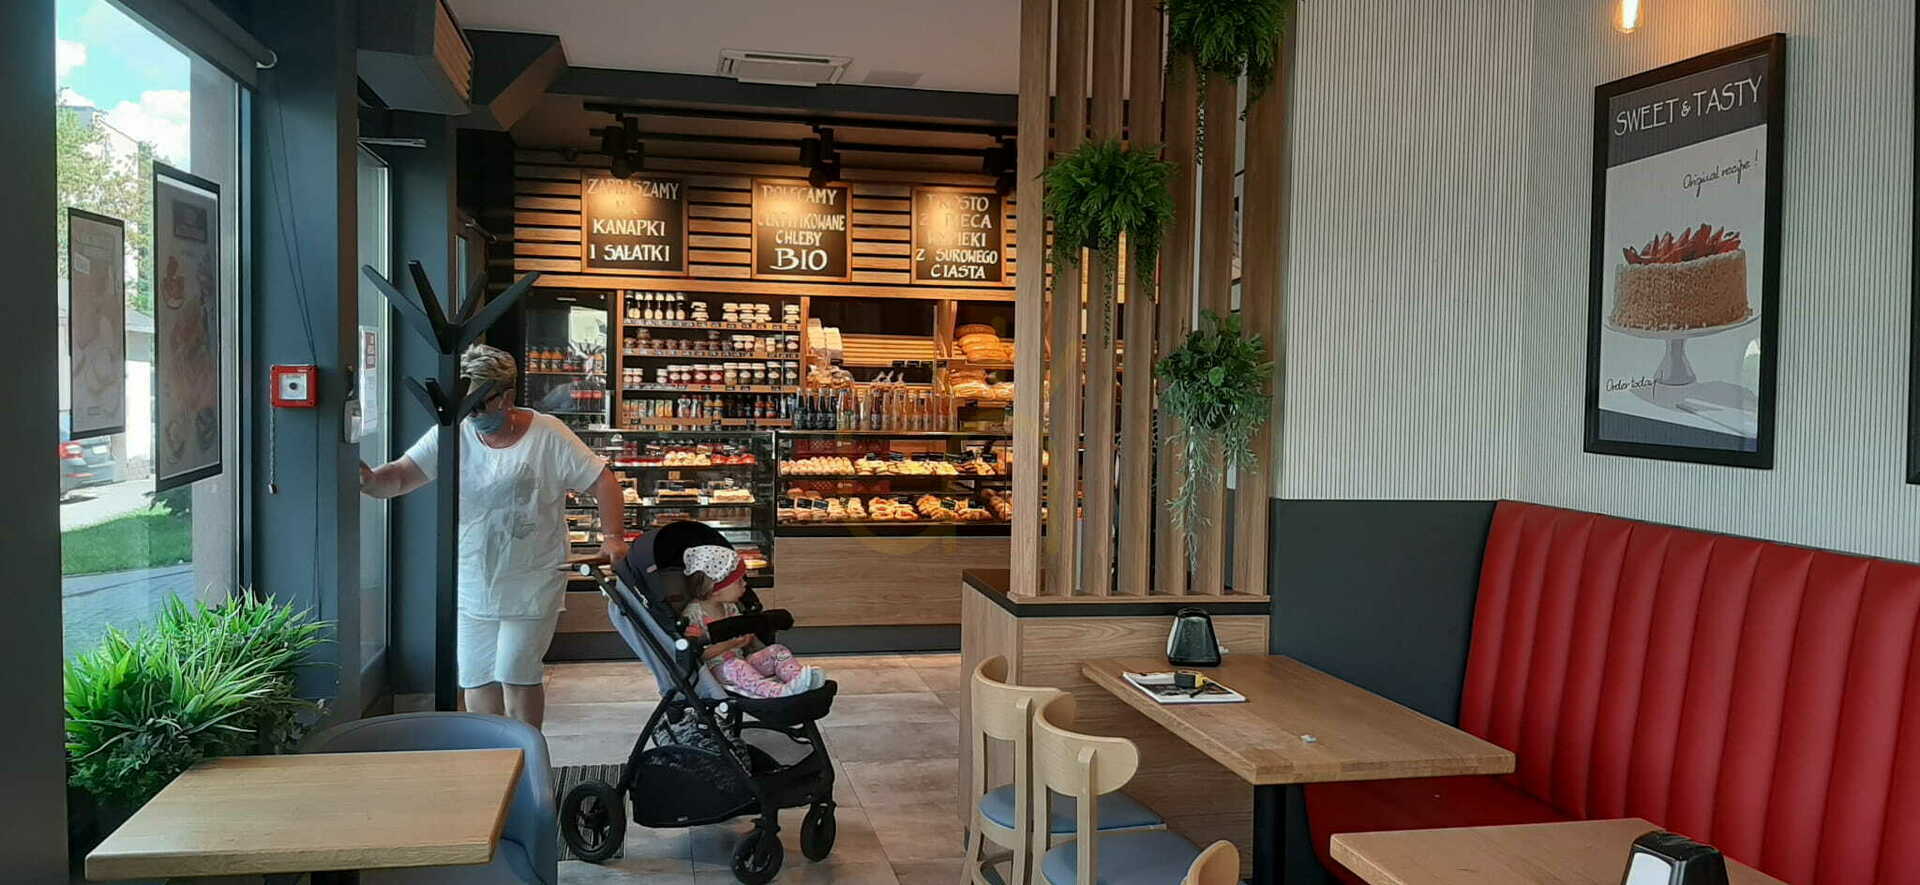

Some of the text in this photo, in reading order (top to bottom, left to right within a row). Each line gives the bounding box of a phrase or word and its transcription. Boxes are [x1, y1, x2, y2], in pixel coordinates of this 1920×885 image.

[1614, 75, 1762, 136] SWEET & TASTY
[593, 219, 665, 236] KANAPKI
[775, 230, 823, 247] CHLEBY
[589, 243, 670, 262] I SAŁATKI
[769, 247, 828, 271] BIO
[915, 248, 998, 264] Z SUROWEGO
[930, 264, 986, 279] CIASTA
